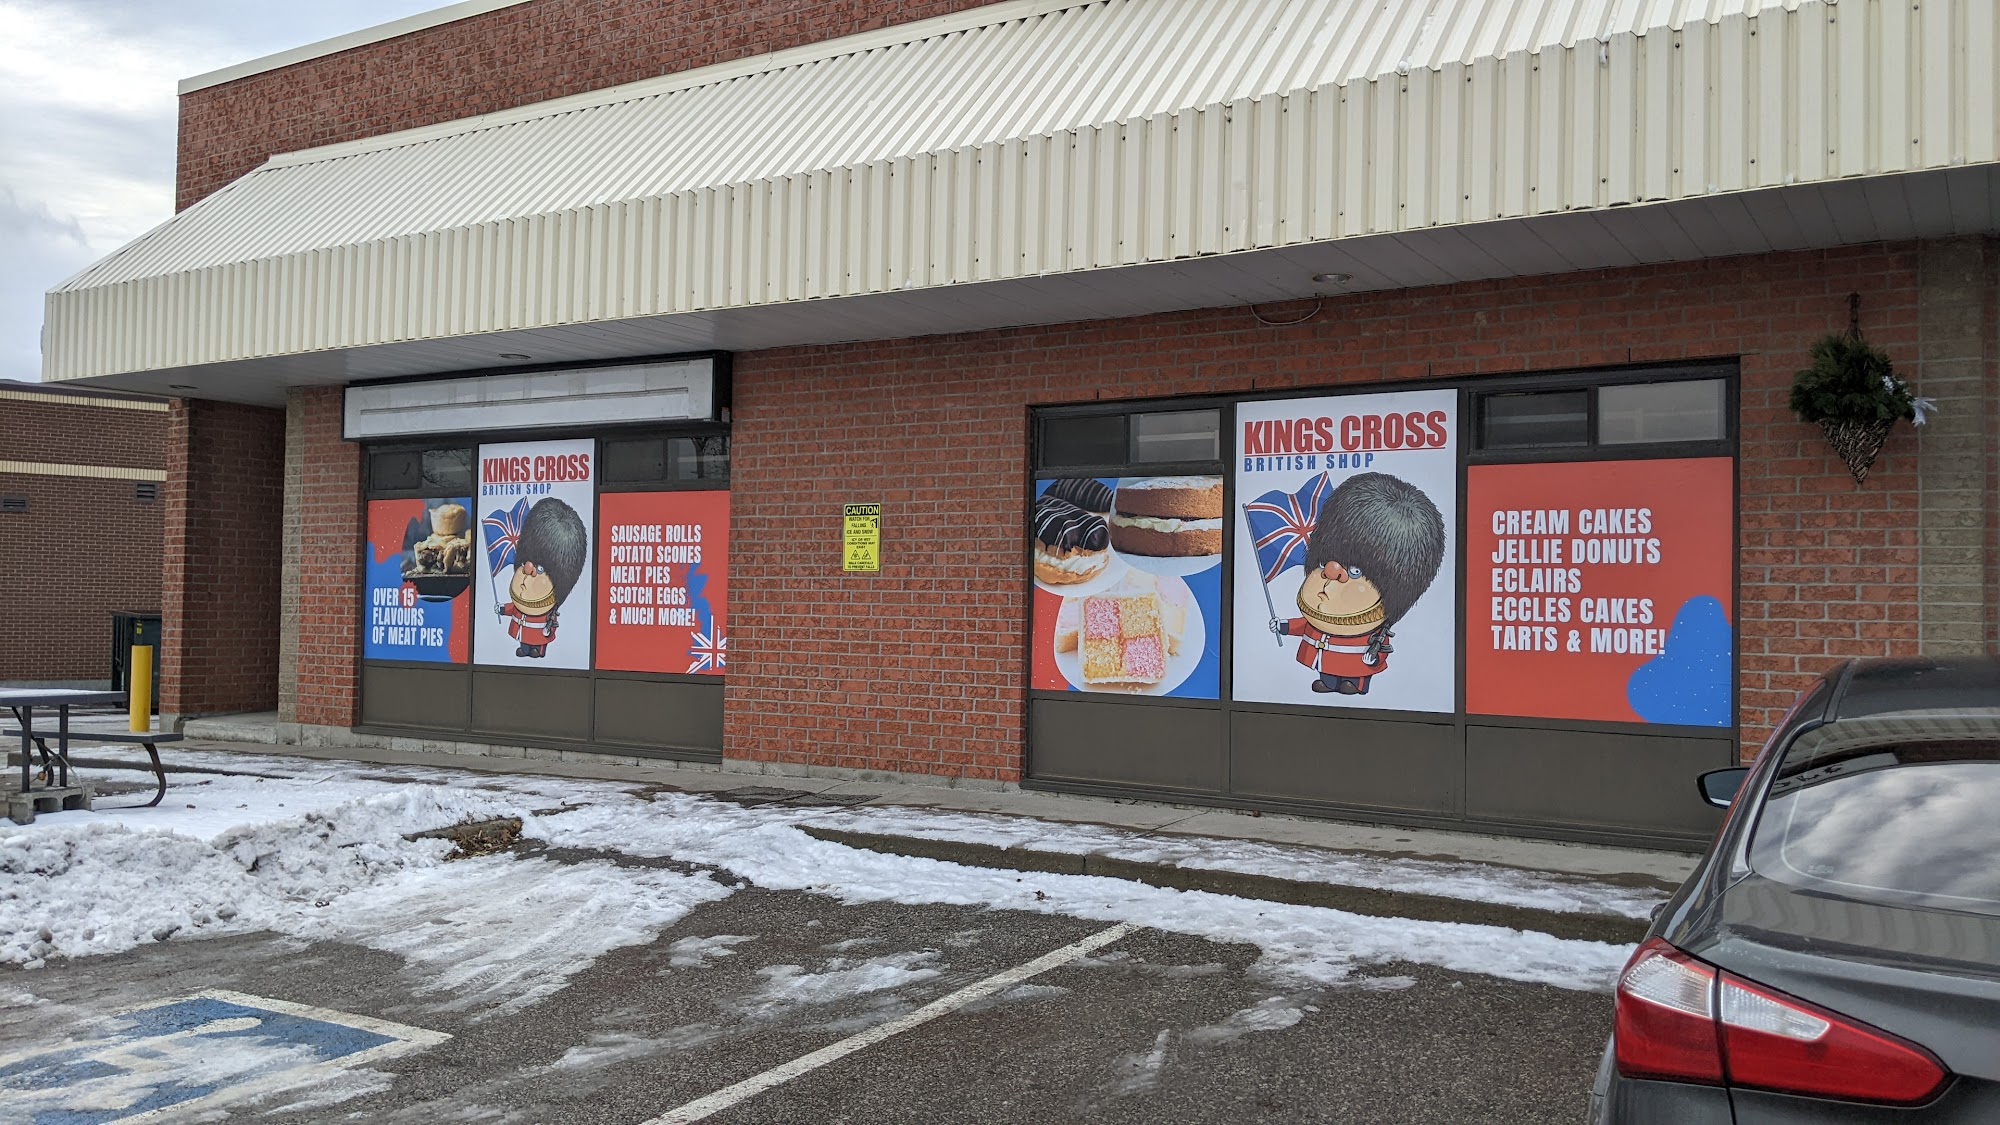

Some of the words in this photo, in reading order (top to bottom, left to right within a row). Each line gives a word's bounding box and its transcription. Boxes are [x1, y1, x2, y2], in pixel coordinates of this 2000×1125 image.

[1244, 416, 1334, 455] KINGS
[1340, 410, 1448, 451] CROSS
[482, 455, 531, 483] KINGS
[533, 453, 590, 482] CROSS
[1244, 454, 1316, 472] BRITISH
[1326, 452, 1374, 470] SHOP
[482, 483, 521, 496] BRITISH
[526, 482, 552, 495] SHOP
[846, 506, 878, 515] CAUTION
[1492, 509, 1570, 535] CREAM
[1578, 507, 1652, 534] CAKES
[611, 524, 662, 543] SAUSAGE
[665, 524, 702, 543] ROLLS
[610, 545, 653, 563] POTATO
[656, 545, 702, 564] SCONES
[1491, 539, 1563, 564] JELLIE
[1571, 538, 1661, 564] DONUTS
[610, 565, 642, 584] MEAT
[645, 565, 671, 584] PIES
[1491, 567, 1582, 594] ECLAIRS
[373, 587, 399, 606] OVER
[402, 587, 415, 607] 15
[609, 586, 653, 604] SCOTCH
[656, 586, 687, 605] EGGS
[372, 606, 425, 627] FLAVOURS
[609, 608, 617, 625] &
[620, 606, 654, 625] MUCH
[658, 607, 696, 627] MORE!
[1491, 596, 1571, 623] ECCLES
[1580, 597, 1654, 624] CAKES
[372, 625, 385, 645] OF
[387, 626, 417, 646] MEAT
[420, 627, 444, 647] PIES
[1490, 625, 1558, 652] TARTS
[1566, 629, 1581, 653] &
[1590, 627, 1666, 655] MORE!
